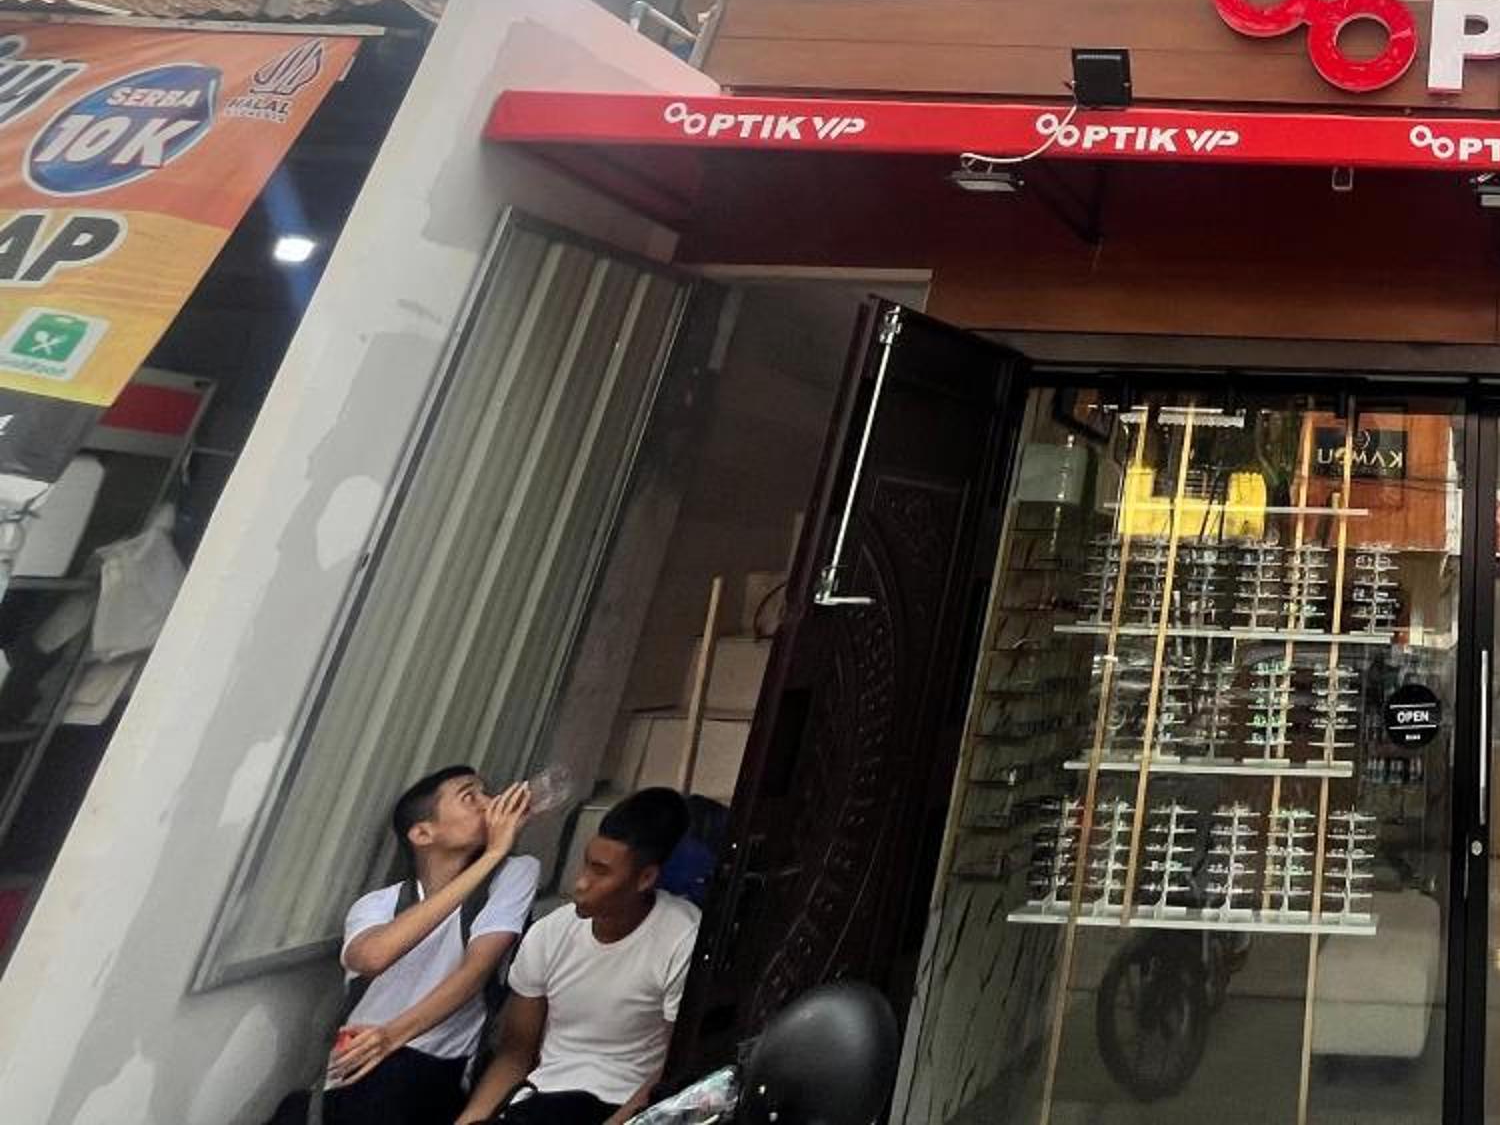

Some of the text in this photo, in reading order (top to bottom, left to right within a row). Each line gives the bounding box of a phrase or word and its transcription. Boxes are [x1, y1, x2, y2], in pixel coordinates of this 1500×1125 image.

[106, 86, 202, 109] SERBA
[227, 96, 291, 114] HALAL
[1397, 710, 1430, 723] OPEN
